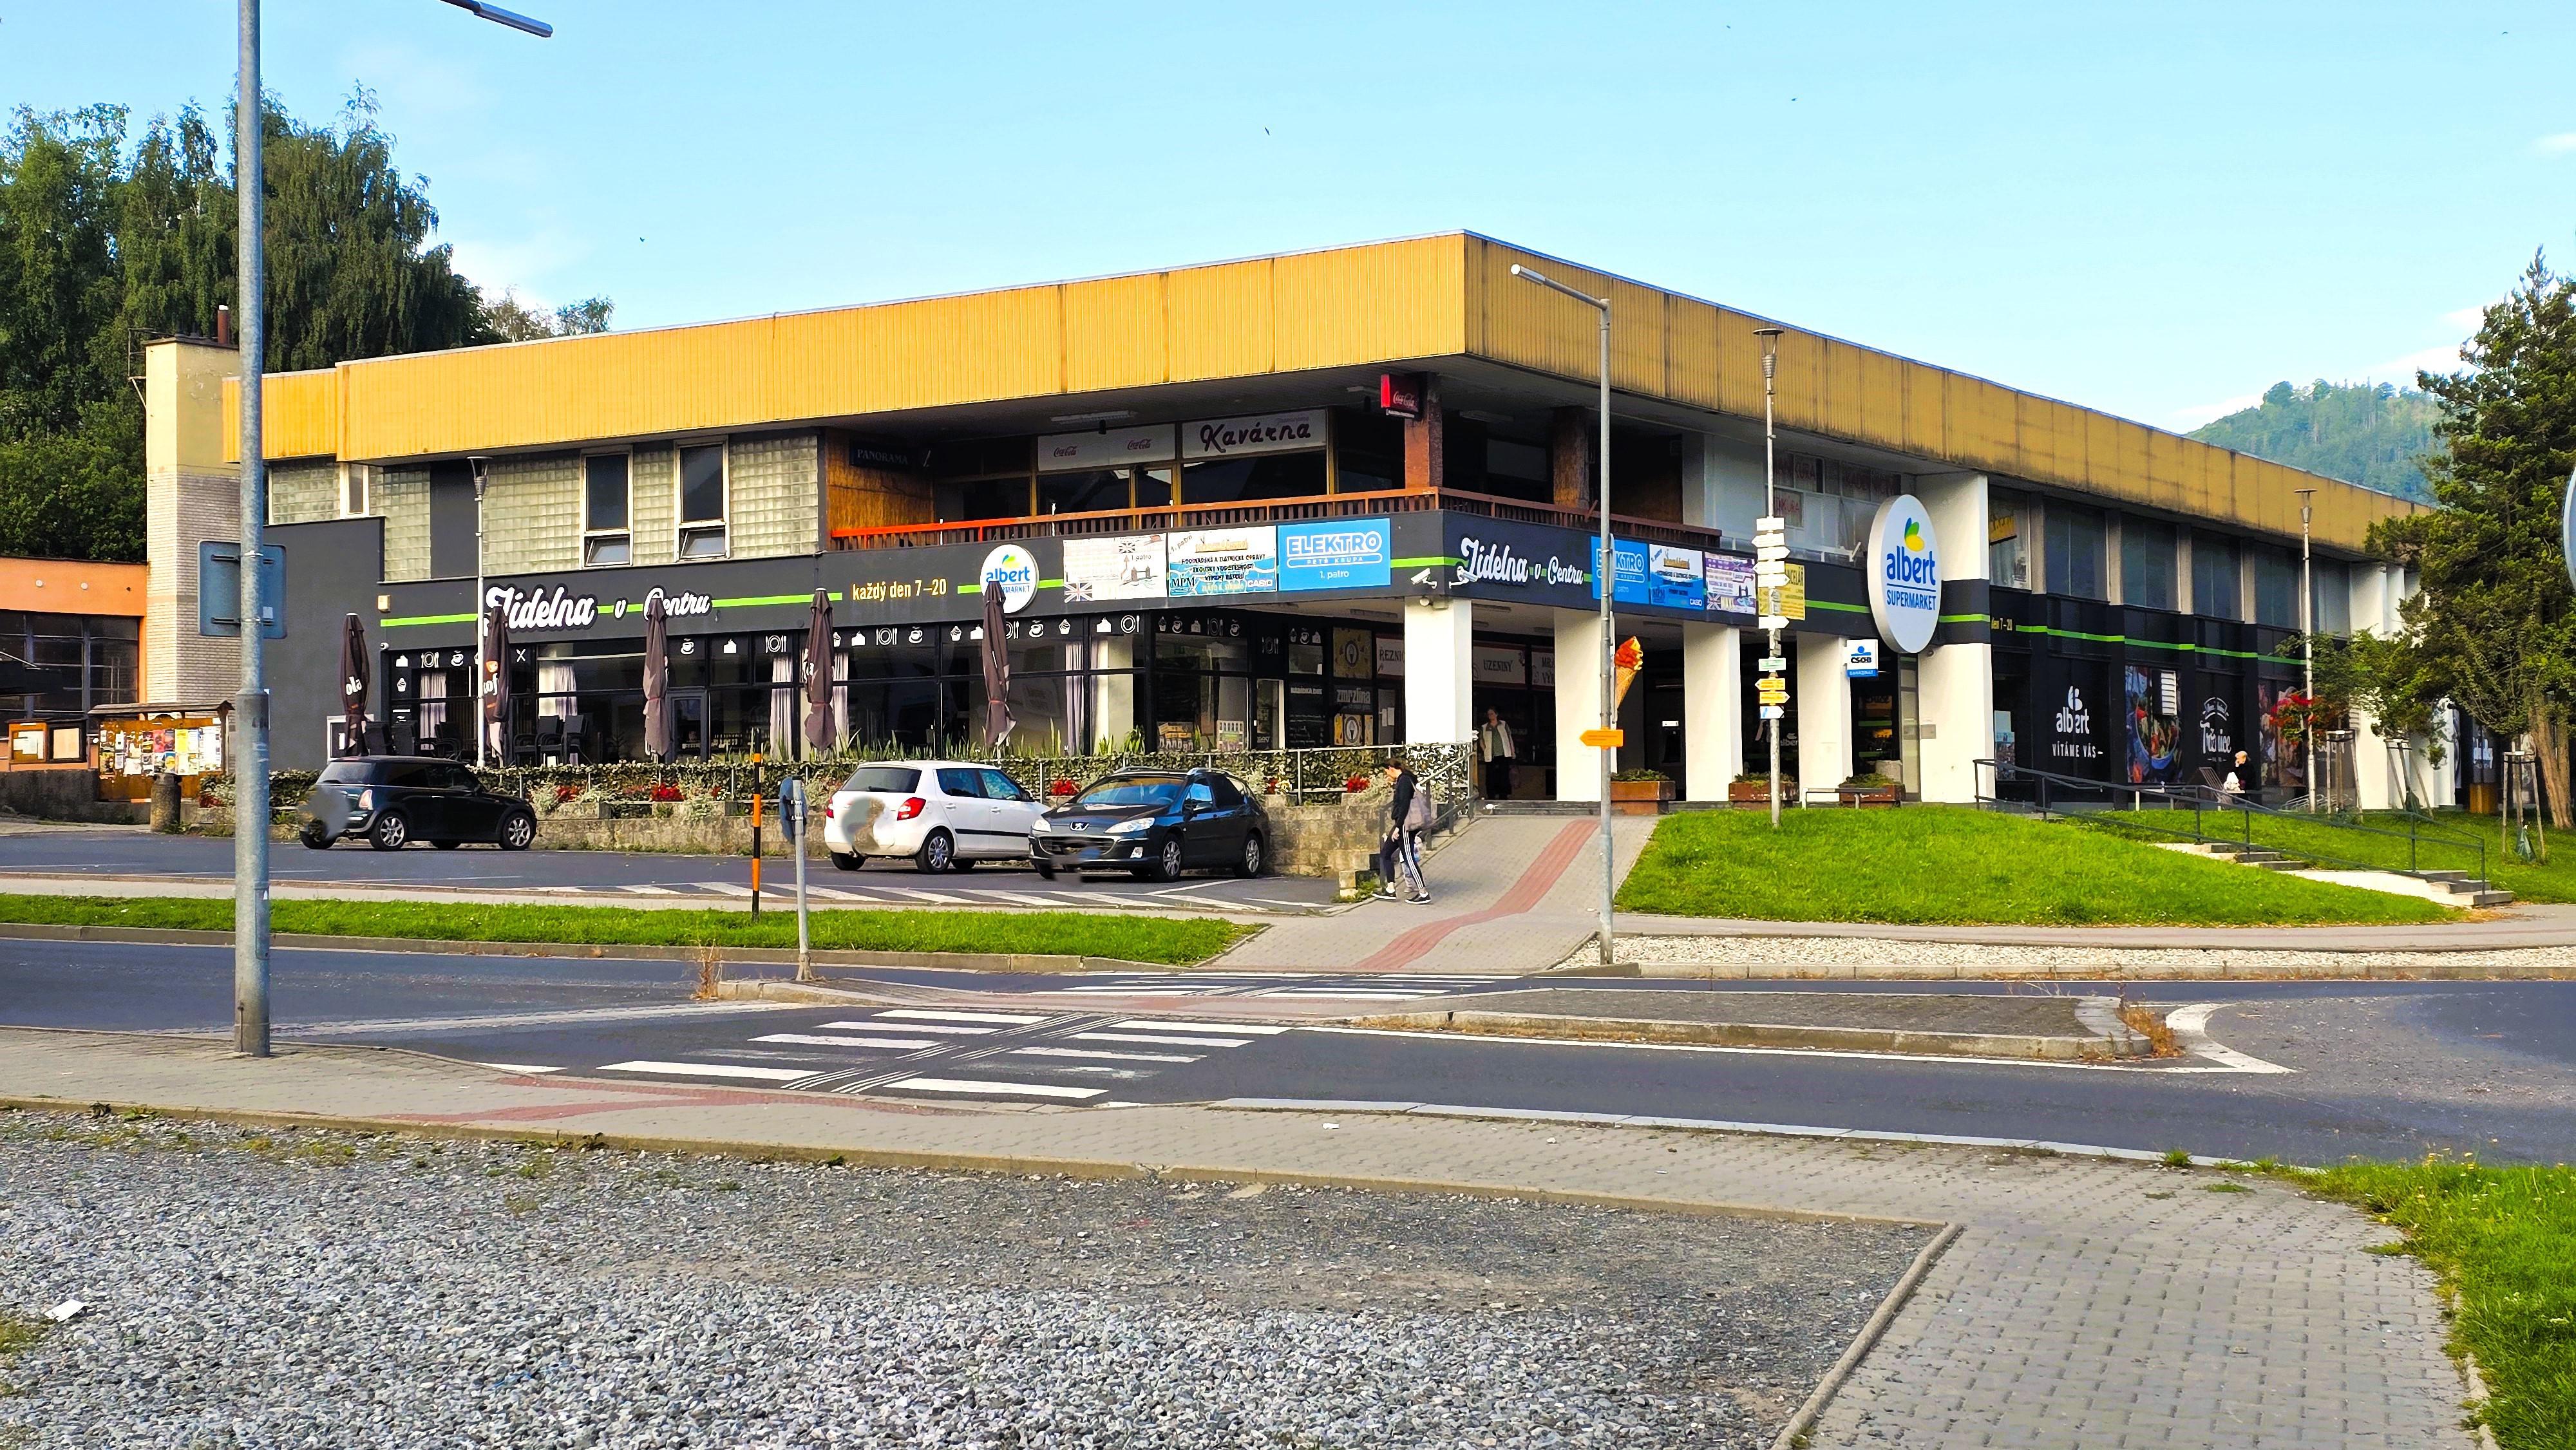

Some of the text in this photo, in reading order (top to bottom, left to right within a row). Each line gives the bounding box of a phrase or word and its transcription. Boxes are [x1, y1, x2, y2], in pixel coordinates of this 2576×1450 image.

[1200, 422, 1311, 453] Kavárna
[857, 449, 908, 464] PANORAMA
[1287, 531, 1382, 556] ELEKTRO
[1461, 537, 1529, 583] Jídelna
[1548, 556, 1583, 585] Centru
[1596, 548, 1645, 573] EKTRO
[1886, 545, 1936, 585] albert
[987, 567, 1030, 583] albert
[1327, 570, 1350, 579] patro
[853, 583, 886, 602] každý
[890, 585, 911, 598] den
[1887, 589, 1936, 610] SUPERMARKET
[485, 587, 595, 636] Jídelna
[345, 676, 362, 695] ola
[2056, 707, 2090, 734] albert
[2052, 740, 2096, 758] VÍTÁME VÁS
